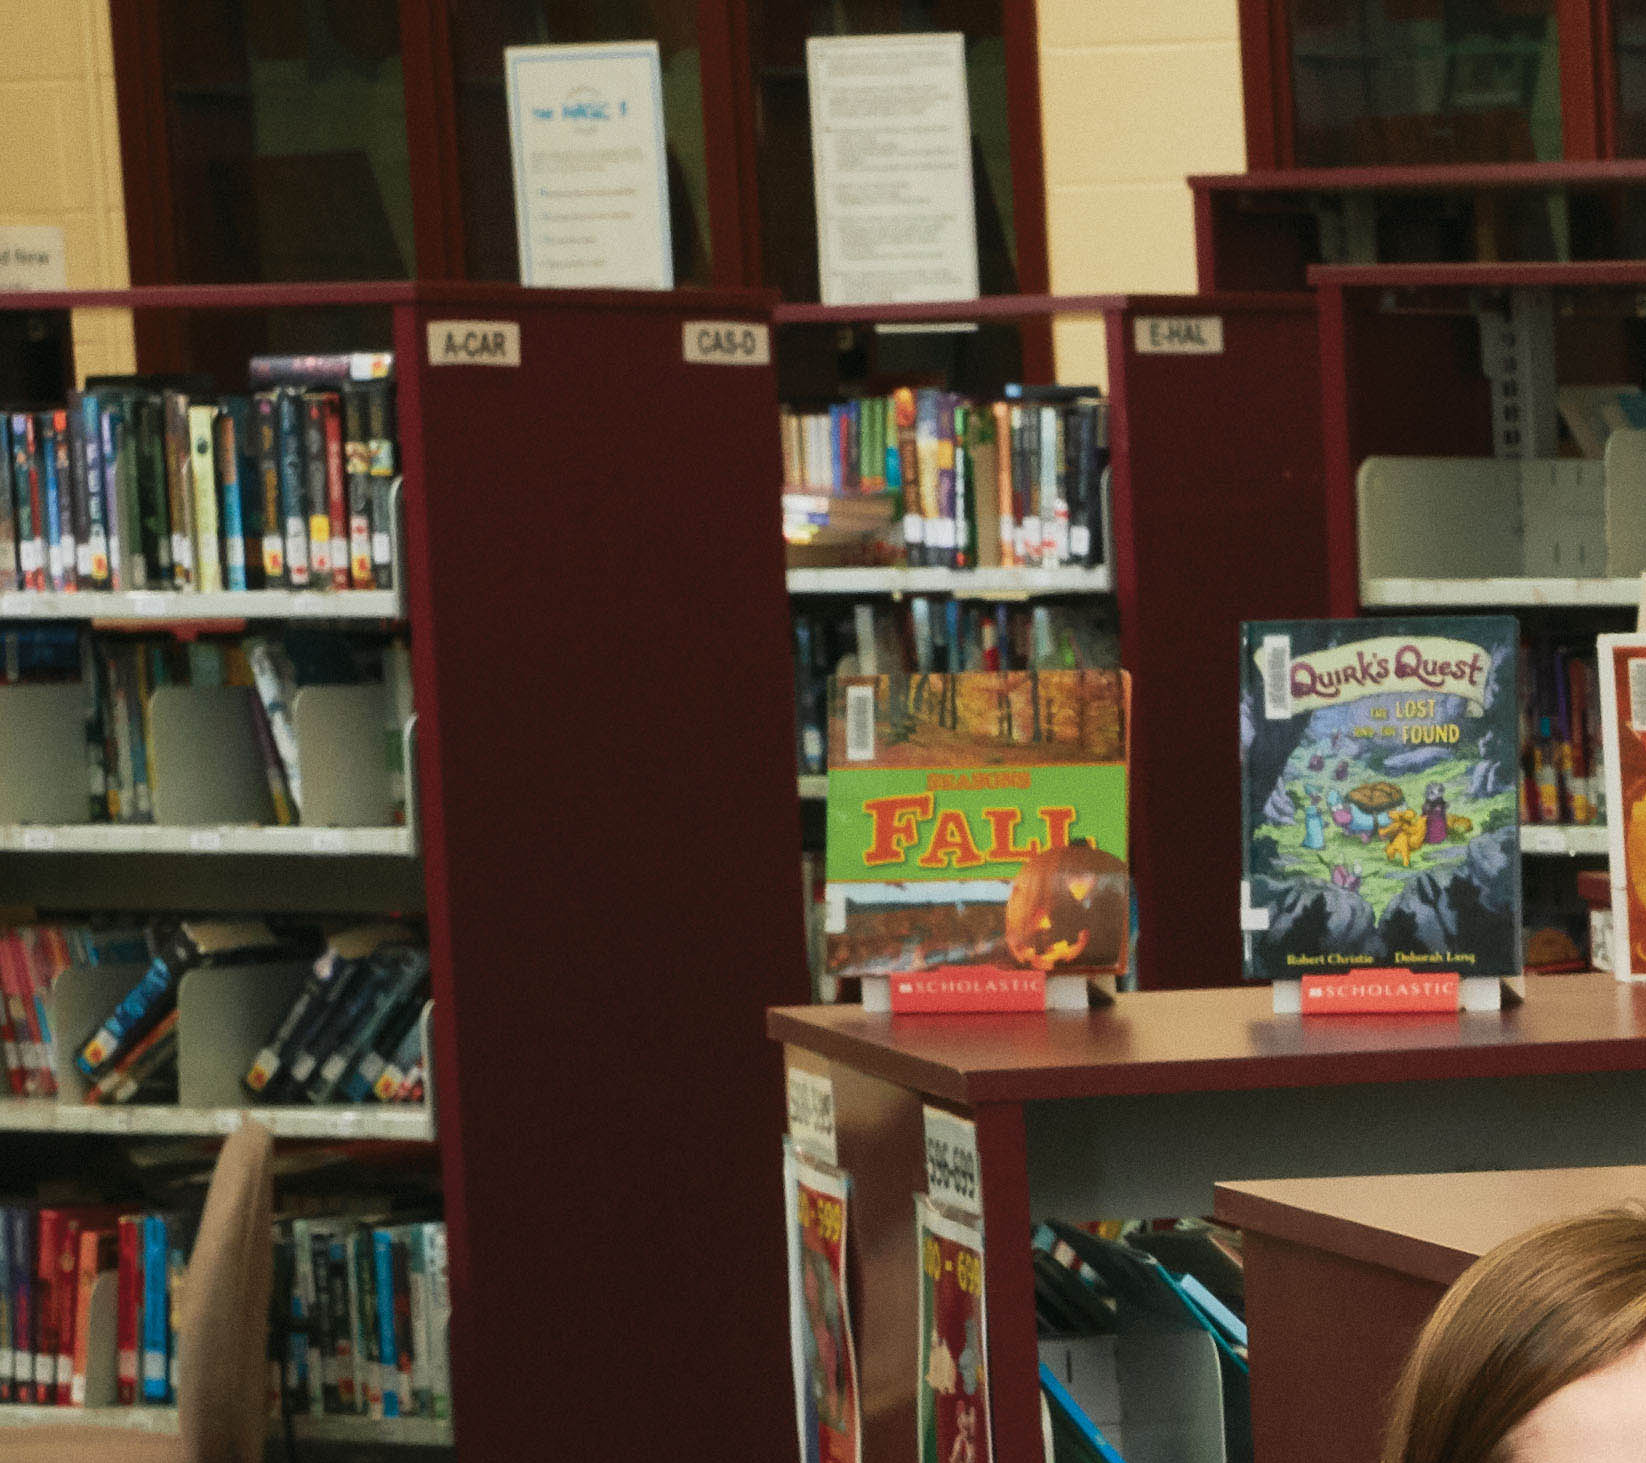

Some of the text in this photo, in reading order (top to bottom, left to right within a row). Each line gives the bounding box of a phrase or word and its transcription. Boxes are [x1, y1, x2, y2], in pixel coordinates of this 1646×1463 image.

[444, 331, 507, 357] A-CAR
[697, 331, 757, 355] CAS-D
[1149, 322, 1206, 346] E-HAL
[1395, 699, 1436, 719] LOST
[1402, 724, 1460, 744] FOUND
[861, 791, 1094, 871] FALL
[916, 976, 1041, 996] SCHOLASTIC
[1326, 980, 1457, 1000] SCHOLASTIC
